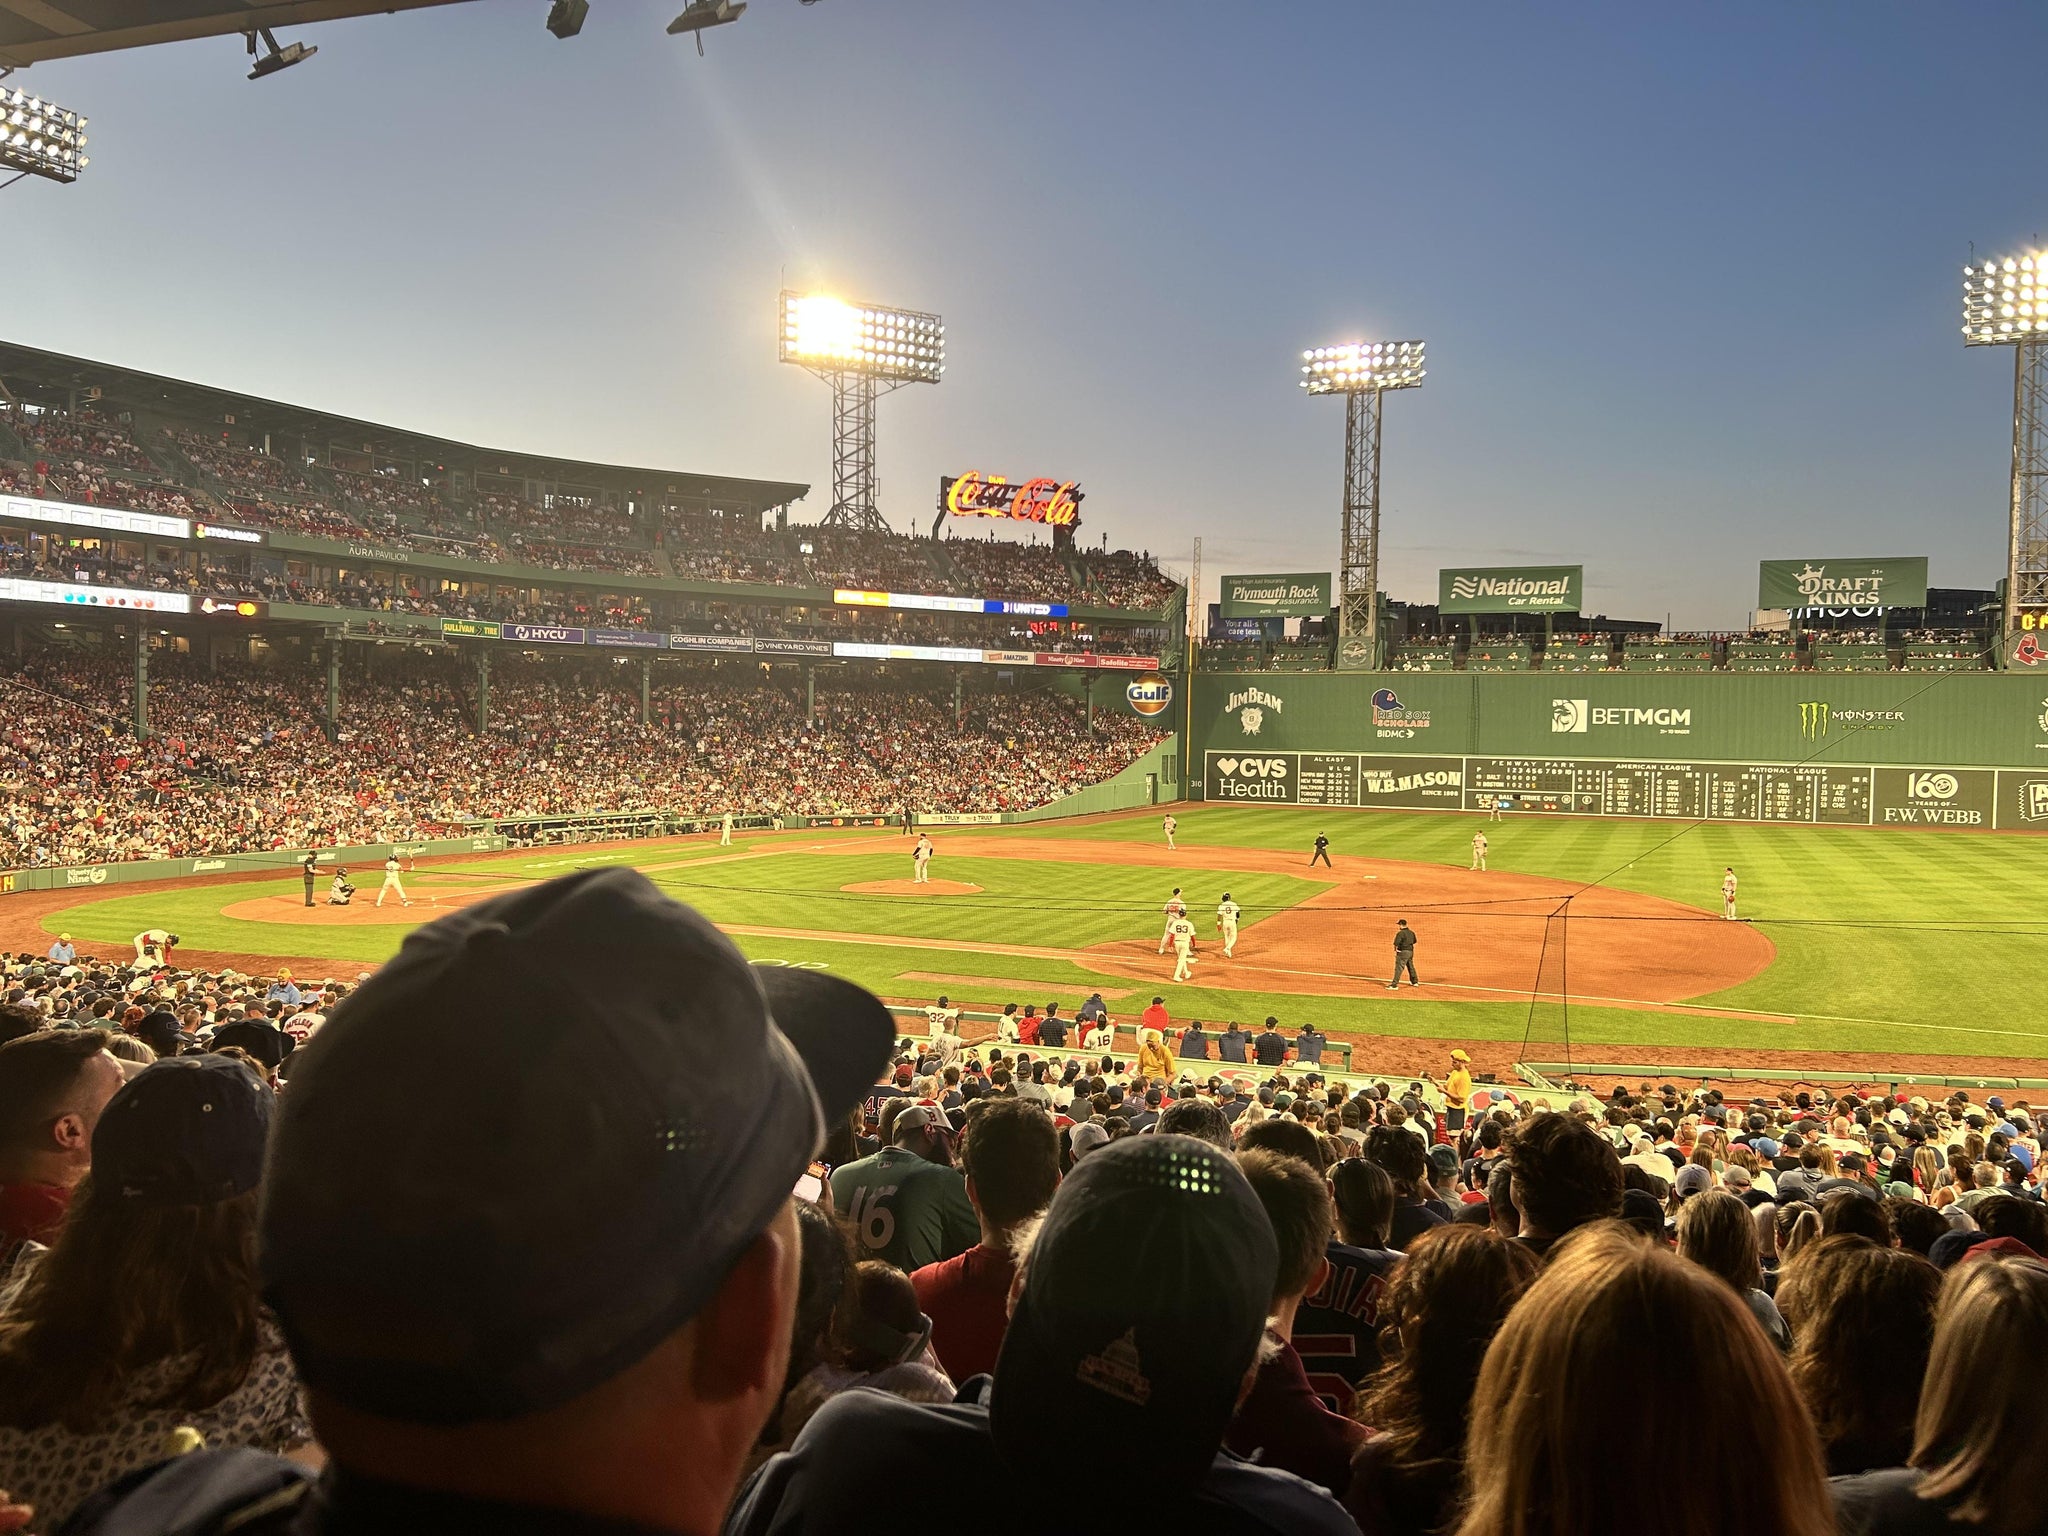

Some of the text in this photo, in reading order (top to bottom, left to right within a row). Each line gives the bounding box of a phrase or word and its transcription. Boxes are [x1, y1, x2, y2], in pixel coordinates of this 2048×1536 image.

[948, 470, 1077, 525] Coca Cola
[375, 550, 408, 561] PAVILION
[1477, 576, 1570, 596] National
[1798, 577, 1883, 594] DRAFT
[1232, 585, 1320, 600] Plymouth Rock
[1808, 591, 1880, 605] KINGS
[1508, 596, 1564, 605] Car Rental
[443, 623, 498, 635] SULLIVAN TIRE
[532, 629, 567, 640] HYCU
[672, 636, 752, 646] COGHLIN COMPANIES
[1003, 654, 1029, 662] AMAZING
[1128, 685, 1170, 701] Gulf
[1225, 687, 1283, 714] JIM BEAM
[1378, 711, 1430, 720] RED SOX
[1592, 708, 1691, 726] BETMGM
[1831, 710, 1905, 721] MONSTER
[1377, 719, 1430, 728] SCHOLARS
[1377, 729, 1405, 738] BIDMC
[1239, 758, 1287, 778] CVS
[1190, 780, 1203, 788] 310
[1219, 778, 1287, 798] Health
[1908, 772, 1959, 799] 160
[1883, 807, 1982, 824] F.W. WEBB
[193, 860, 226, 872] Franklin
[67, 876, 90, 884] Nine
[930, 1012, 945, 1023] 32
[928, 1111, 938, 1122] B
[849, 1184, 898, 1250] 16
